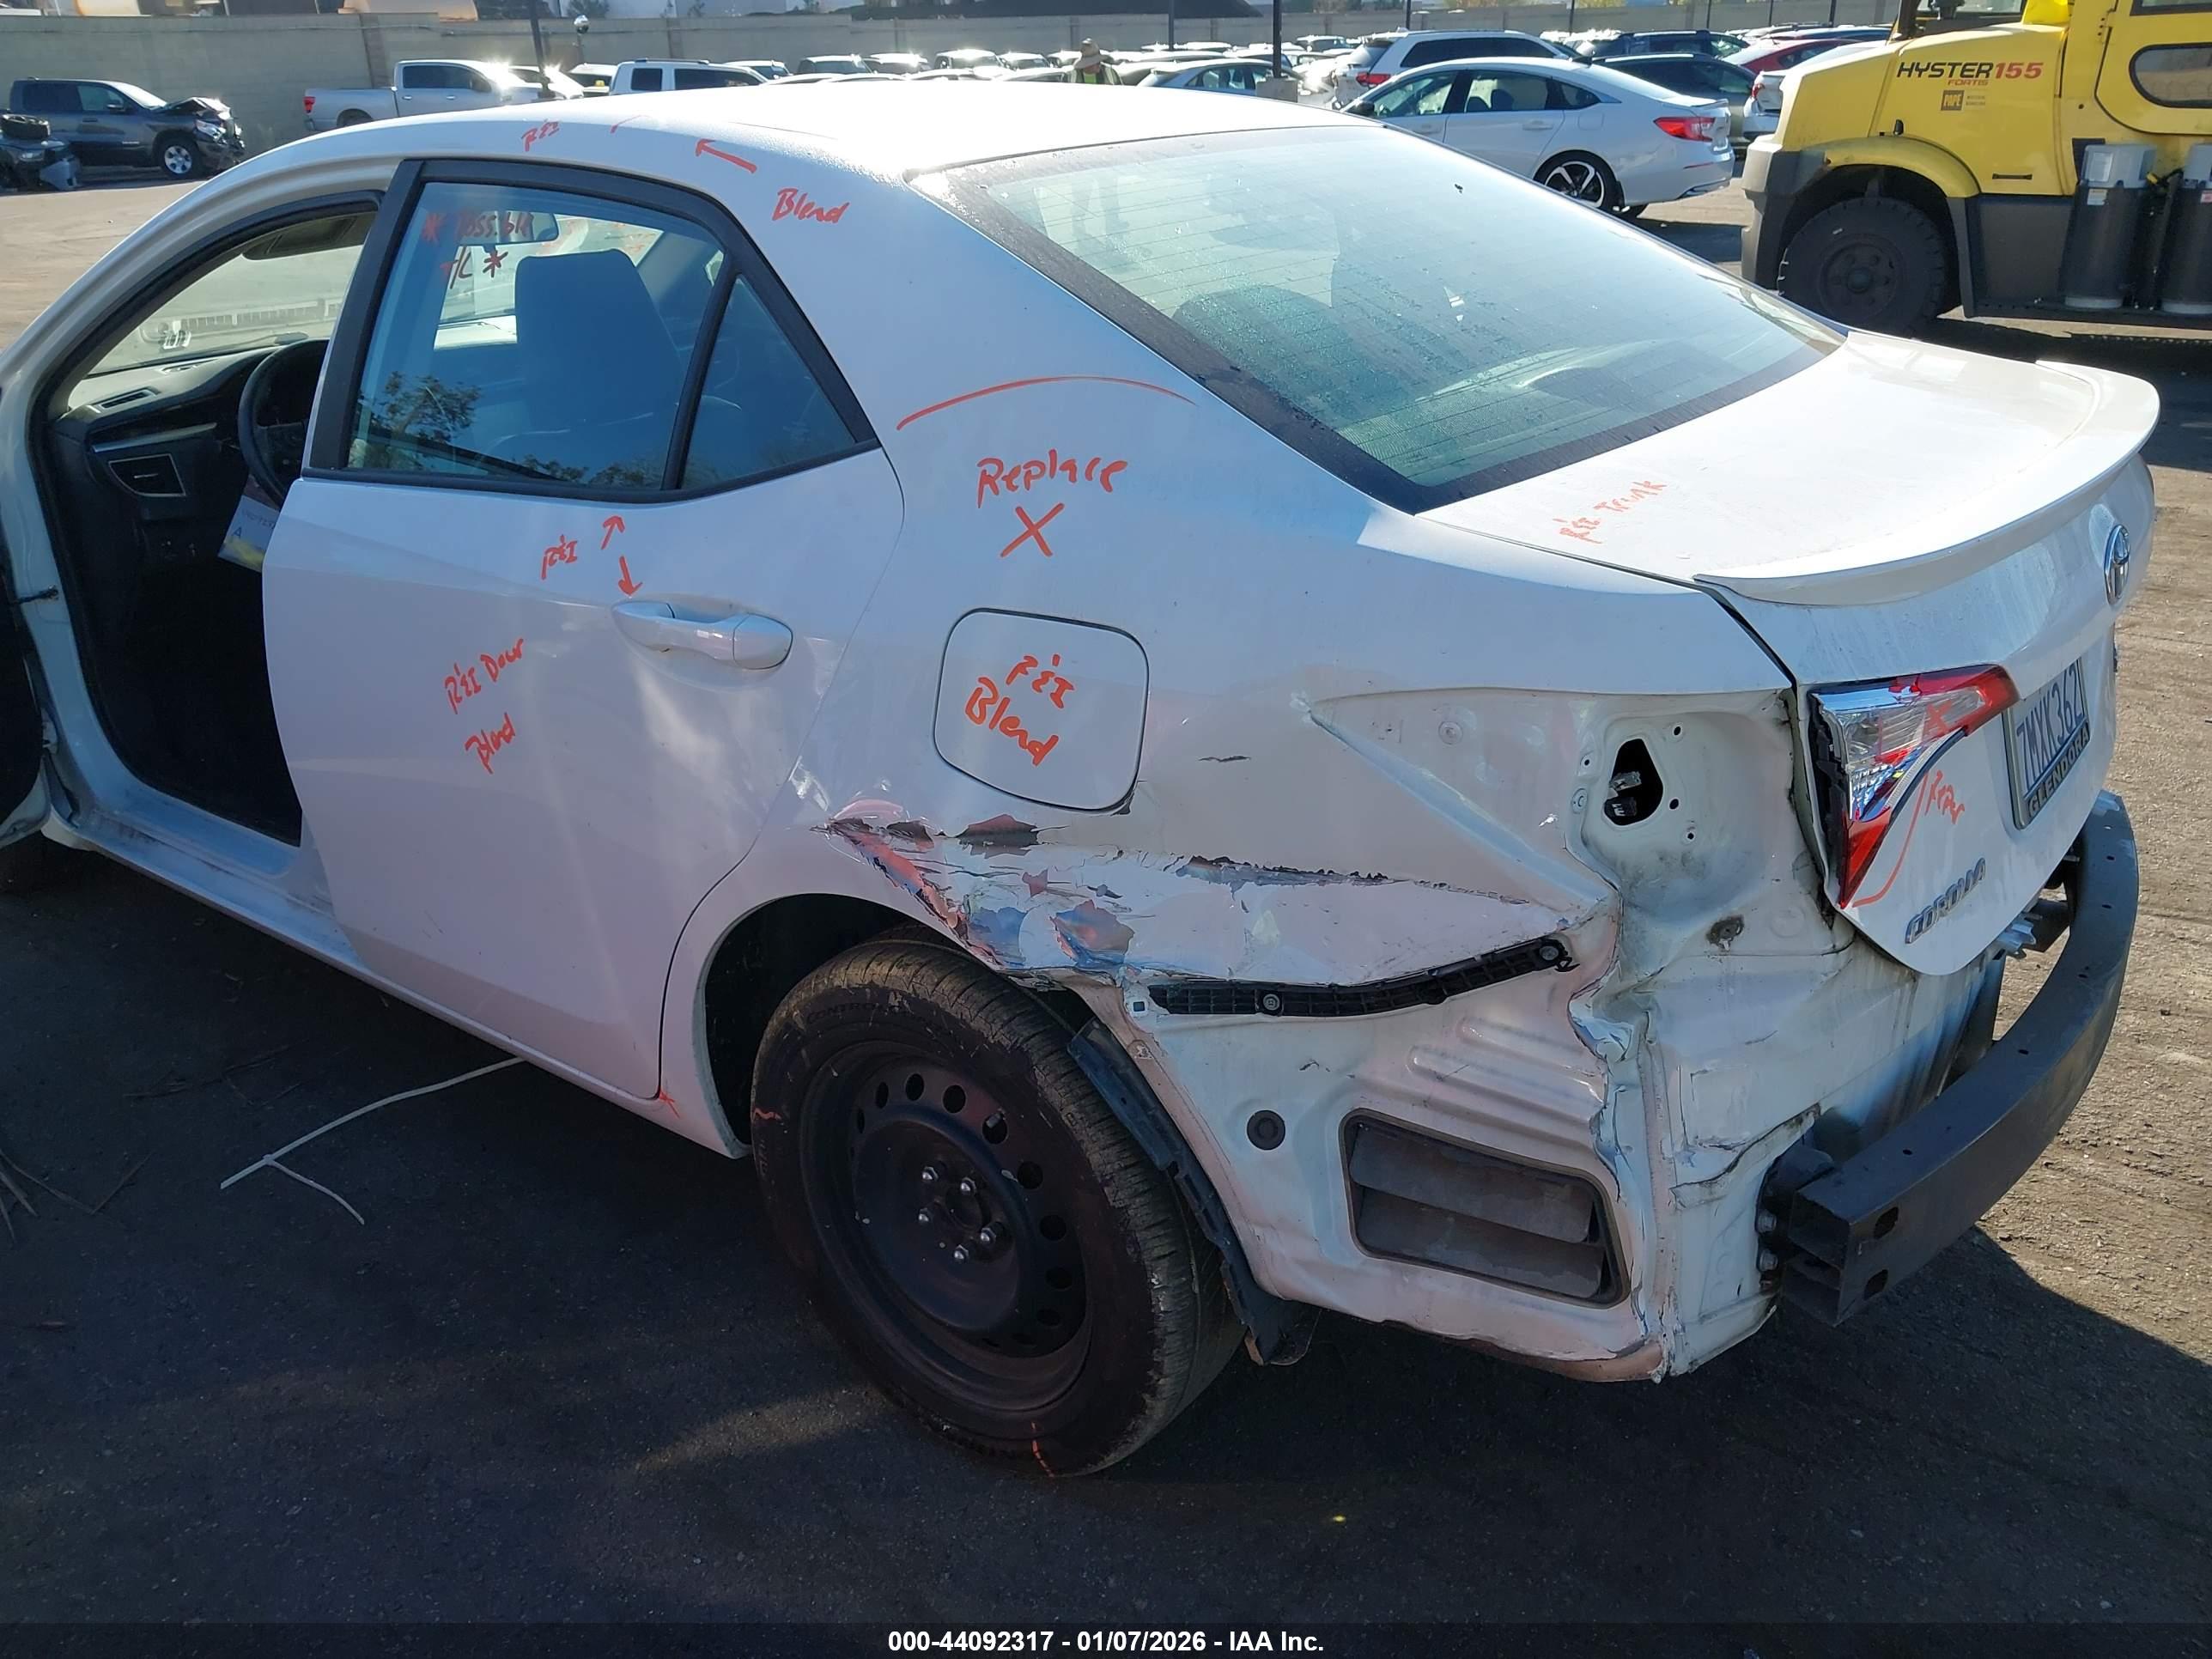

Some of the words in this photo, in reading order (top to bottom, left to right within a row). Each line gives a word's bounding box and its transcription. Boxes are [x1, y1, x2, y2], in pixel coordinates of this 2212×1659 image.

[1896, 62, 1994, 78] HYSTER
[1996, 62, 2044, 79] 155
[772, 187, 850, 224] Blend
[976, 448, 1128, 508] Replace
[965, 677, 1060, 766] Blend
[2016, 662, 2083, 792] 7MXK362
[2027, 721, 2090, 817] GLENDORA
[1905, 857, 1986, 945] COROLLA
